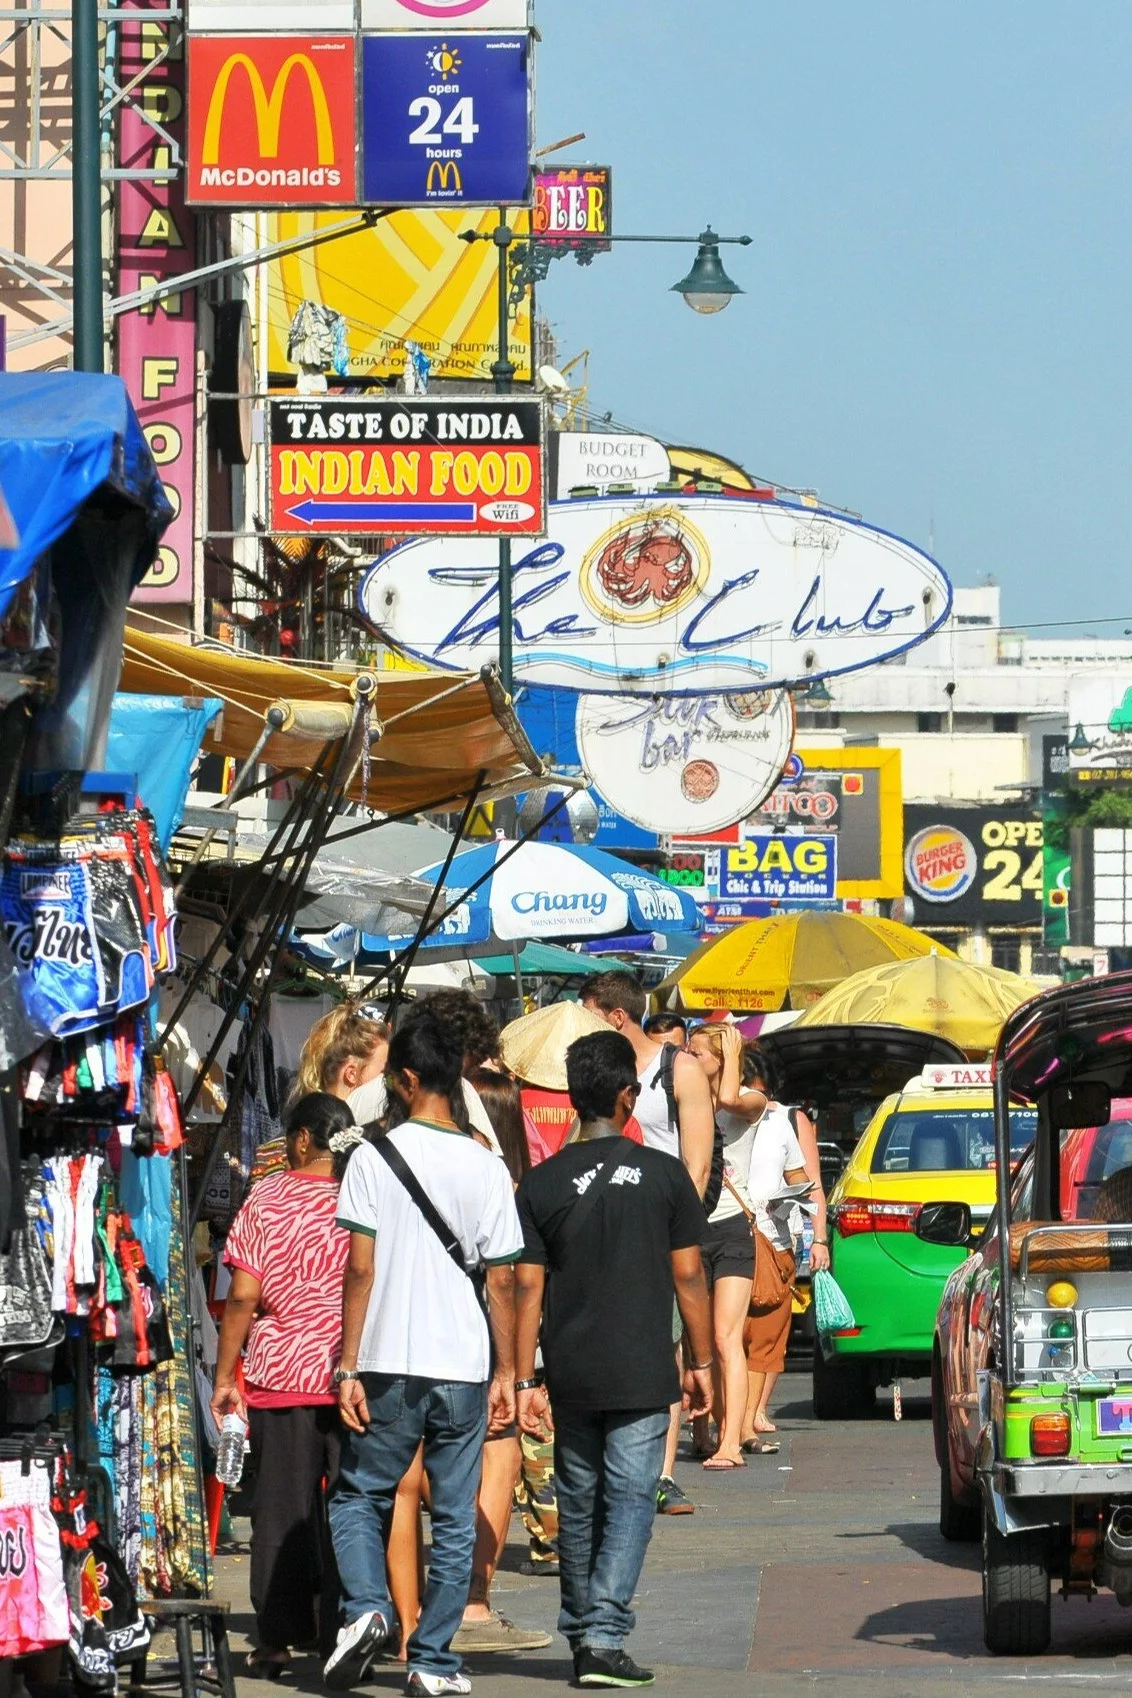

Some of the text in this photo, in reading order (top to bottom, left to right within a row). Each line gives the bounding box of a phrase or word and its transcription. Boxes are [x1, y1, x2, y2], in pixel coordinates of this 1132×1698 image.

[428, 84, 460, 96] open
[408, 96, 479, 144] 24
[426, 147, 462, 158] hours
[139, 22, 183, 316] NDIAN
[200, 166, 341, 188] McDonald's
[533, 185, 605, 232] BEER
[287, 412, 524, 440] TASTE OF INDIA
[579, 440, 648, 457] BUDGET
[279, 450, 532, 497] INDIAN FOOD
[586, 463, 637, 479] ROOM
[492, 508, 519, 520] Wifi
[428, 543, 915, 657] The Club
[982, 820, 1044, 848] OPE
[726, 839, 828, 874] BAG
[916, 841, 964, 866] BURGER
[917, 853, 967, 885] KING
[726, 879, 750, 894] Chic
[750, 880, 762, 894] &
[763, 880, 786, 897] Trip
[510, 890, 608, 915] Chang
[531, 916, 594, 926] DRINKING WATER
[737, 998, 763, 1009] 1126
